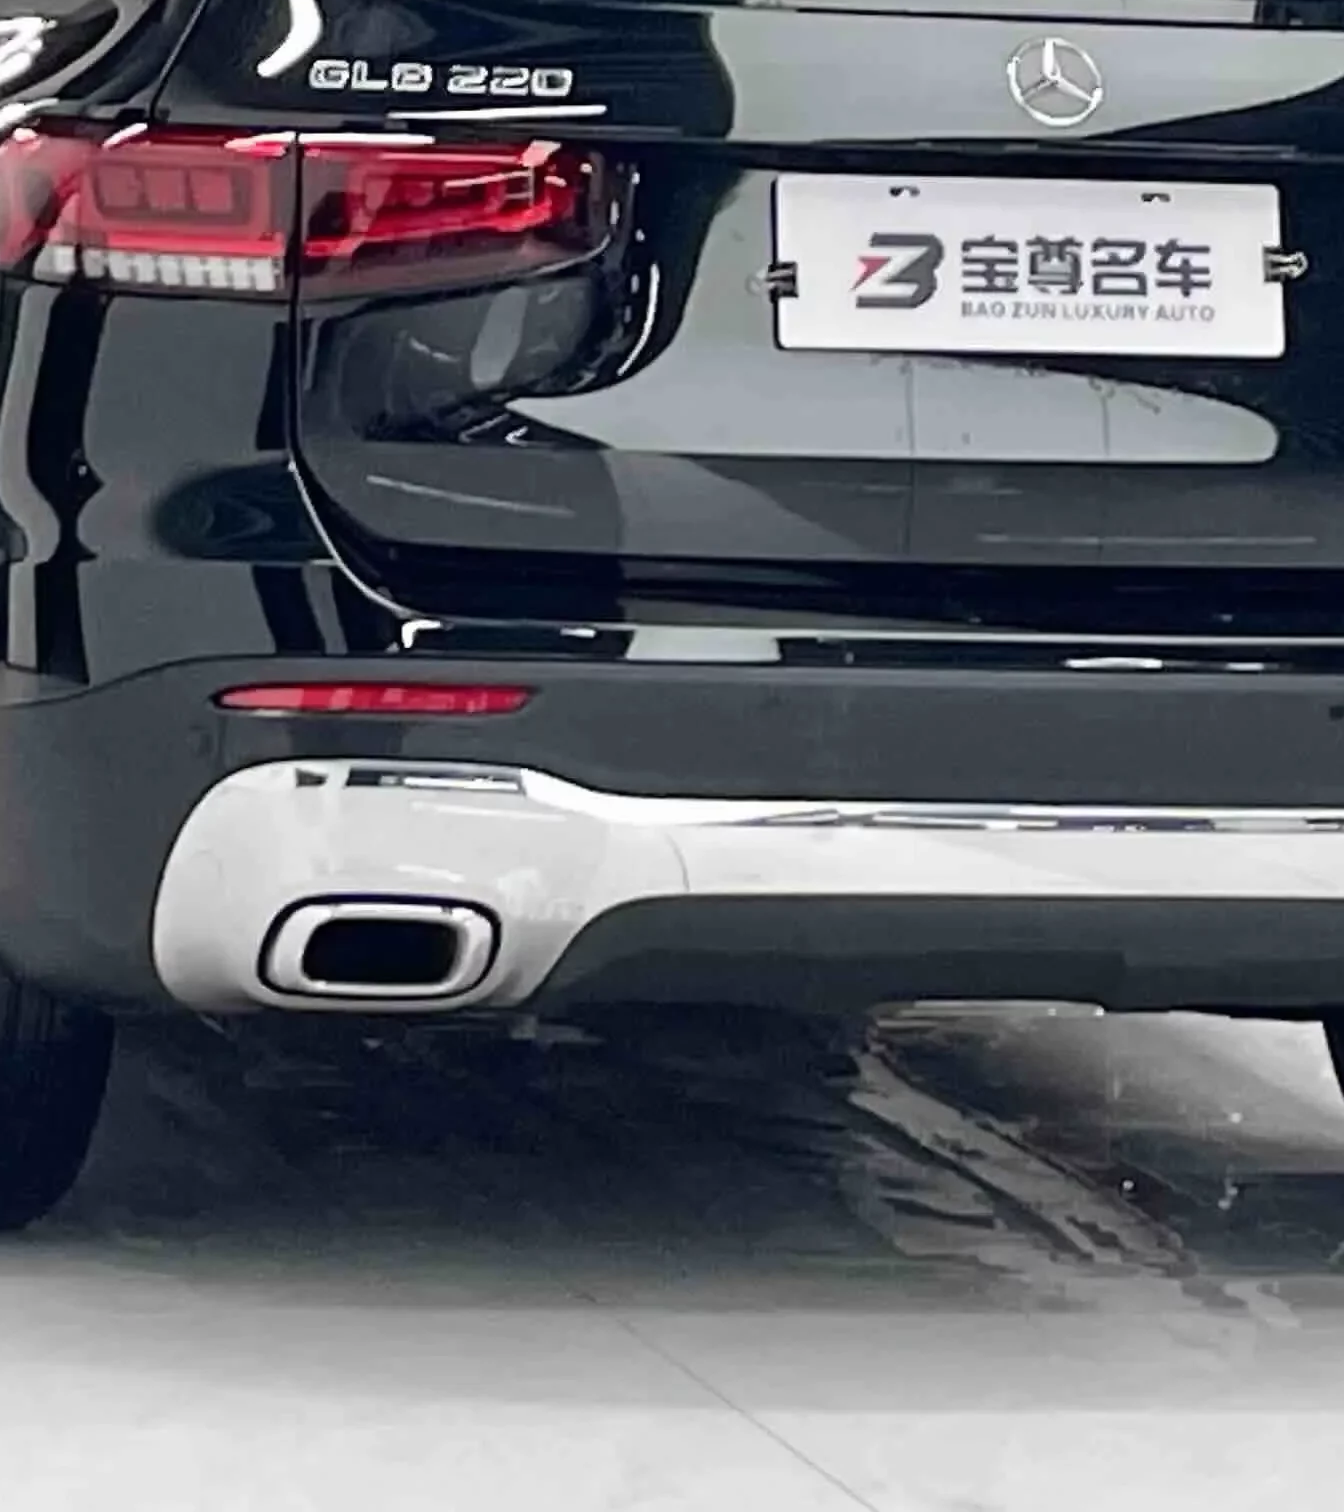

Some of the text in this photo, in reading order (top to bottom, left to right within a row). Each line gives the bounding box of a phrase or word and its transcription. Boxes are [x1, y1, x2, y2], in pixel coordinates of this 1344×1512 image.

[308, 59, 574, 96] GLB 220
[961, 235, 1213, 298] 宝尊名车
[960, 300, 1216, 323] BAO ZUN LUXURY AUTO
